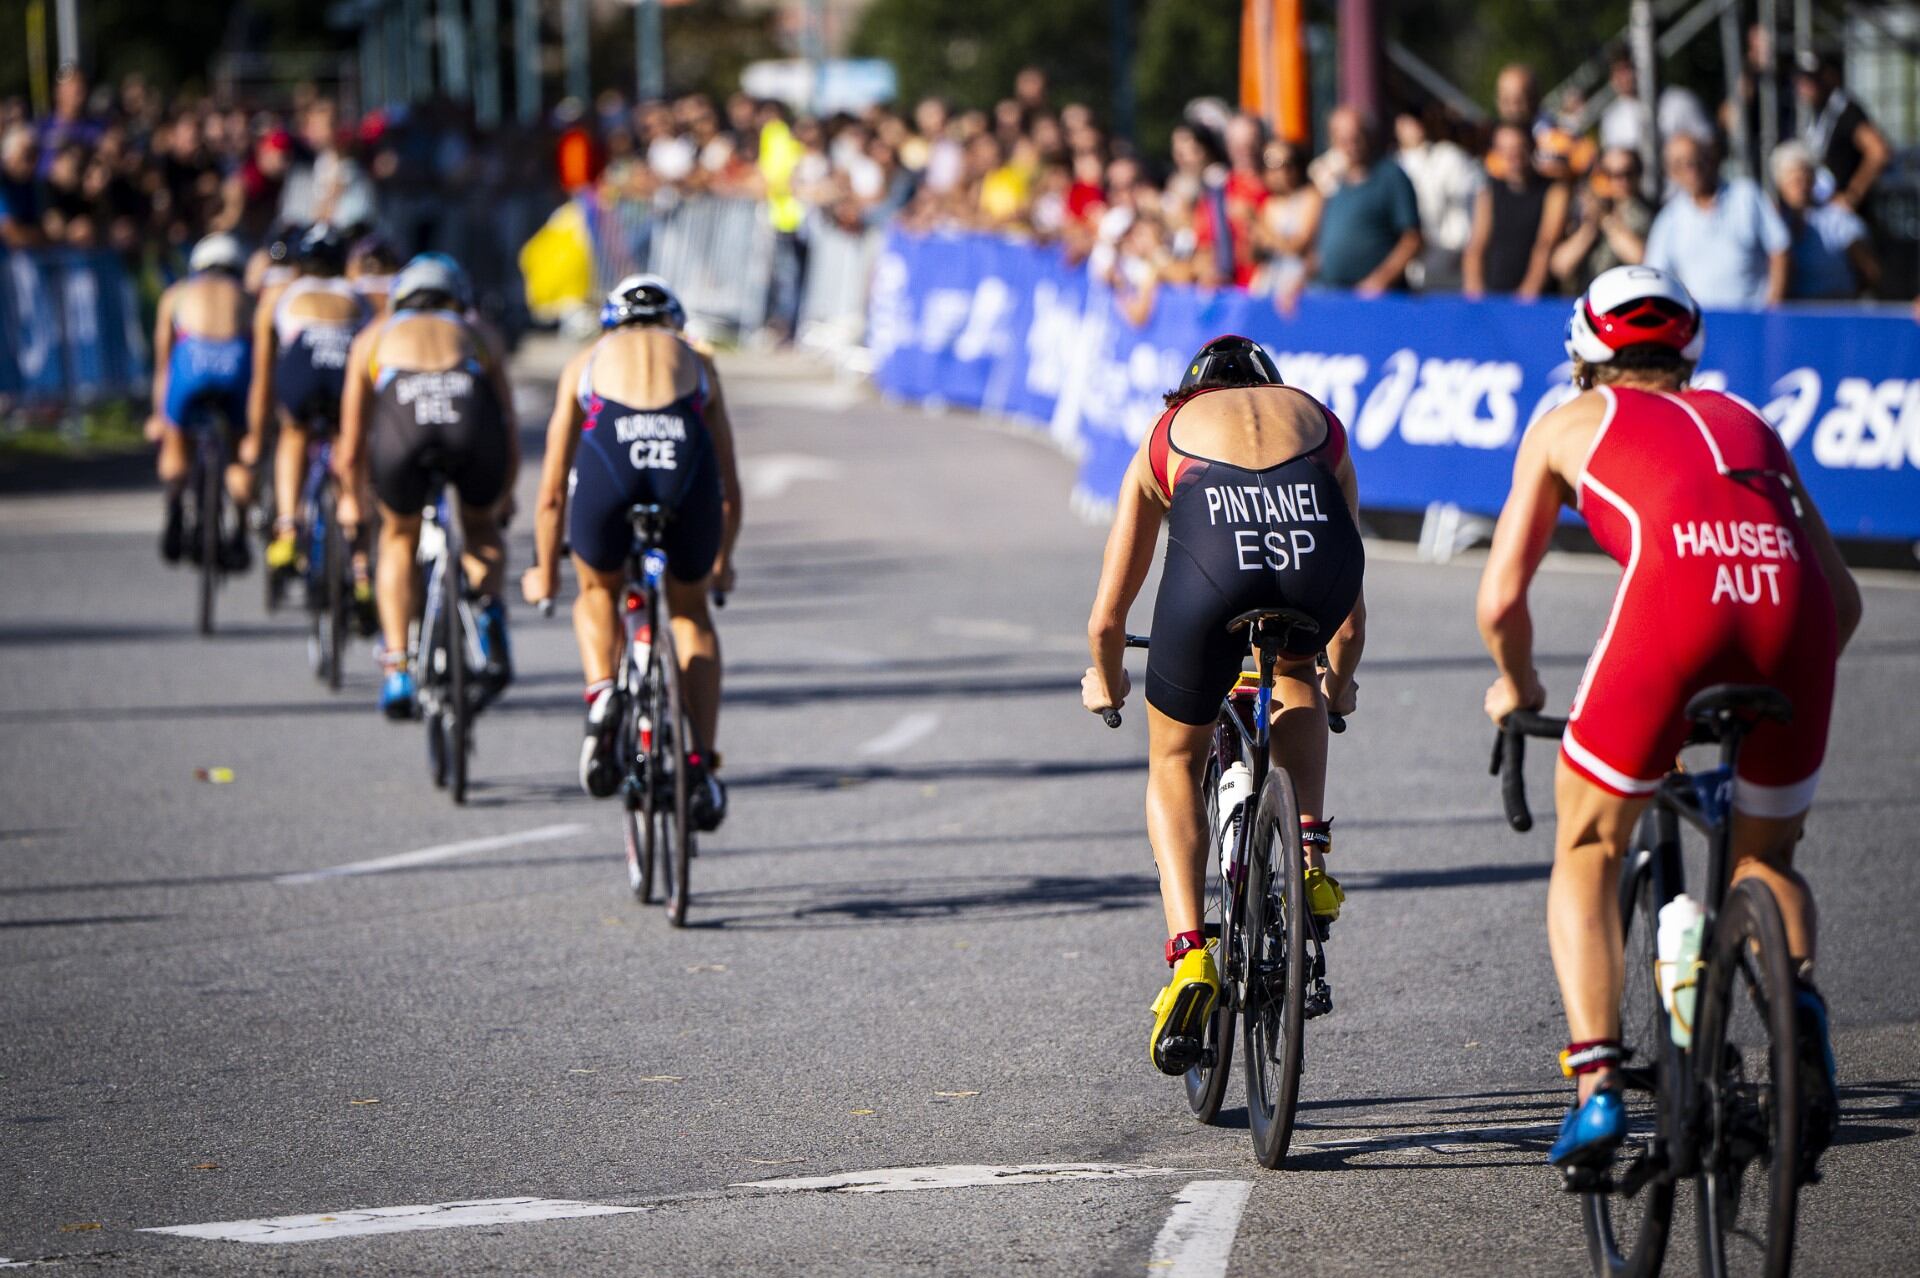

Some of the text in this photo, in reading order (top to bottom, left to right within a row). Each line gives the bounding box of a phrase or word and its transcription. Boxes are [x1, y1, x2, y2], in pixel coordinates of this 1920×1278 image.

[1399, 357, 1523, 449] asics
[629, 440, 677, 470] CZE
[1205, 483, 1328, 525] PINTANEL
[1234, 530, 1316, 571] ESP
[1672, 520, 1800, 562] HAUSER
[1711, 564, 1781, 606] AUT
